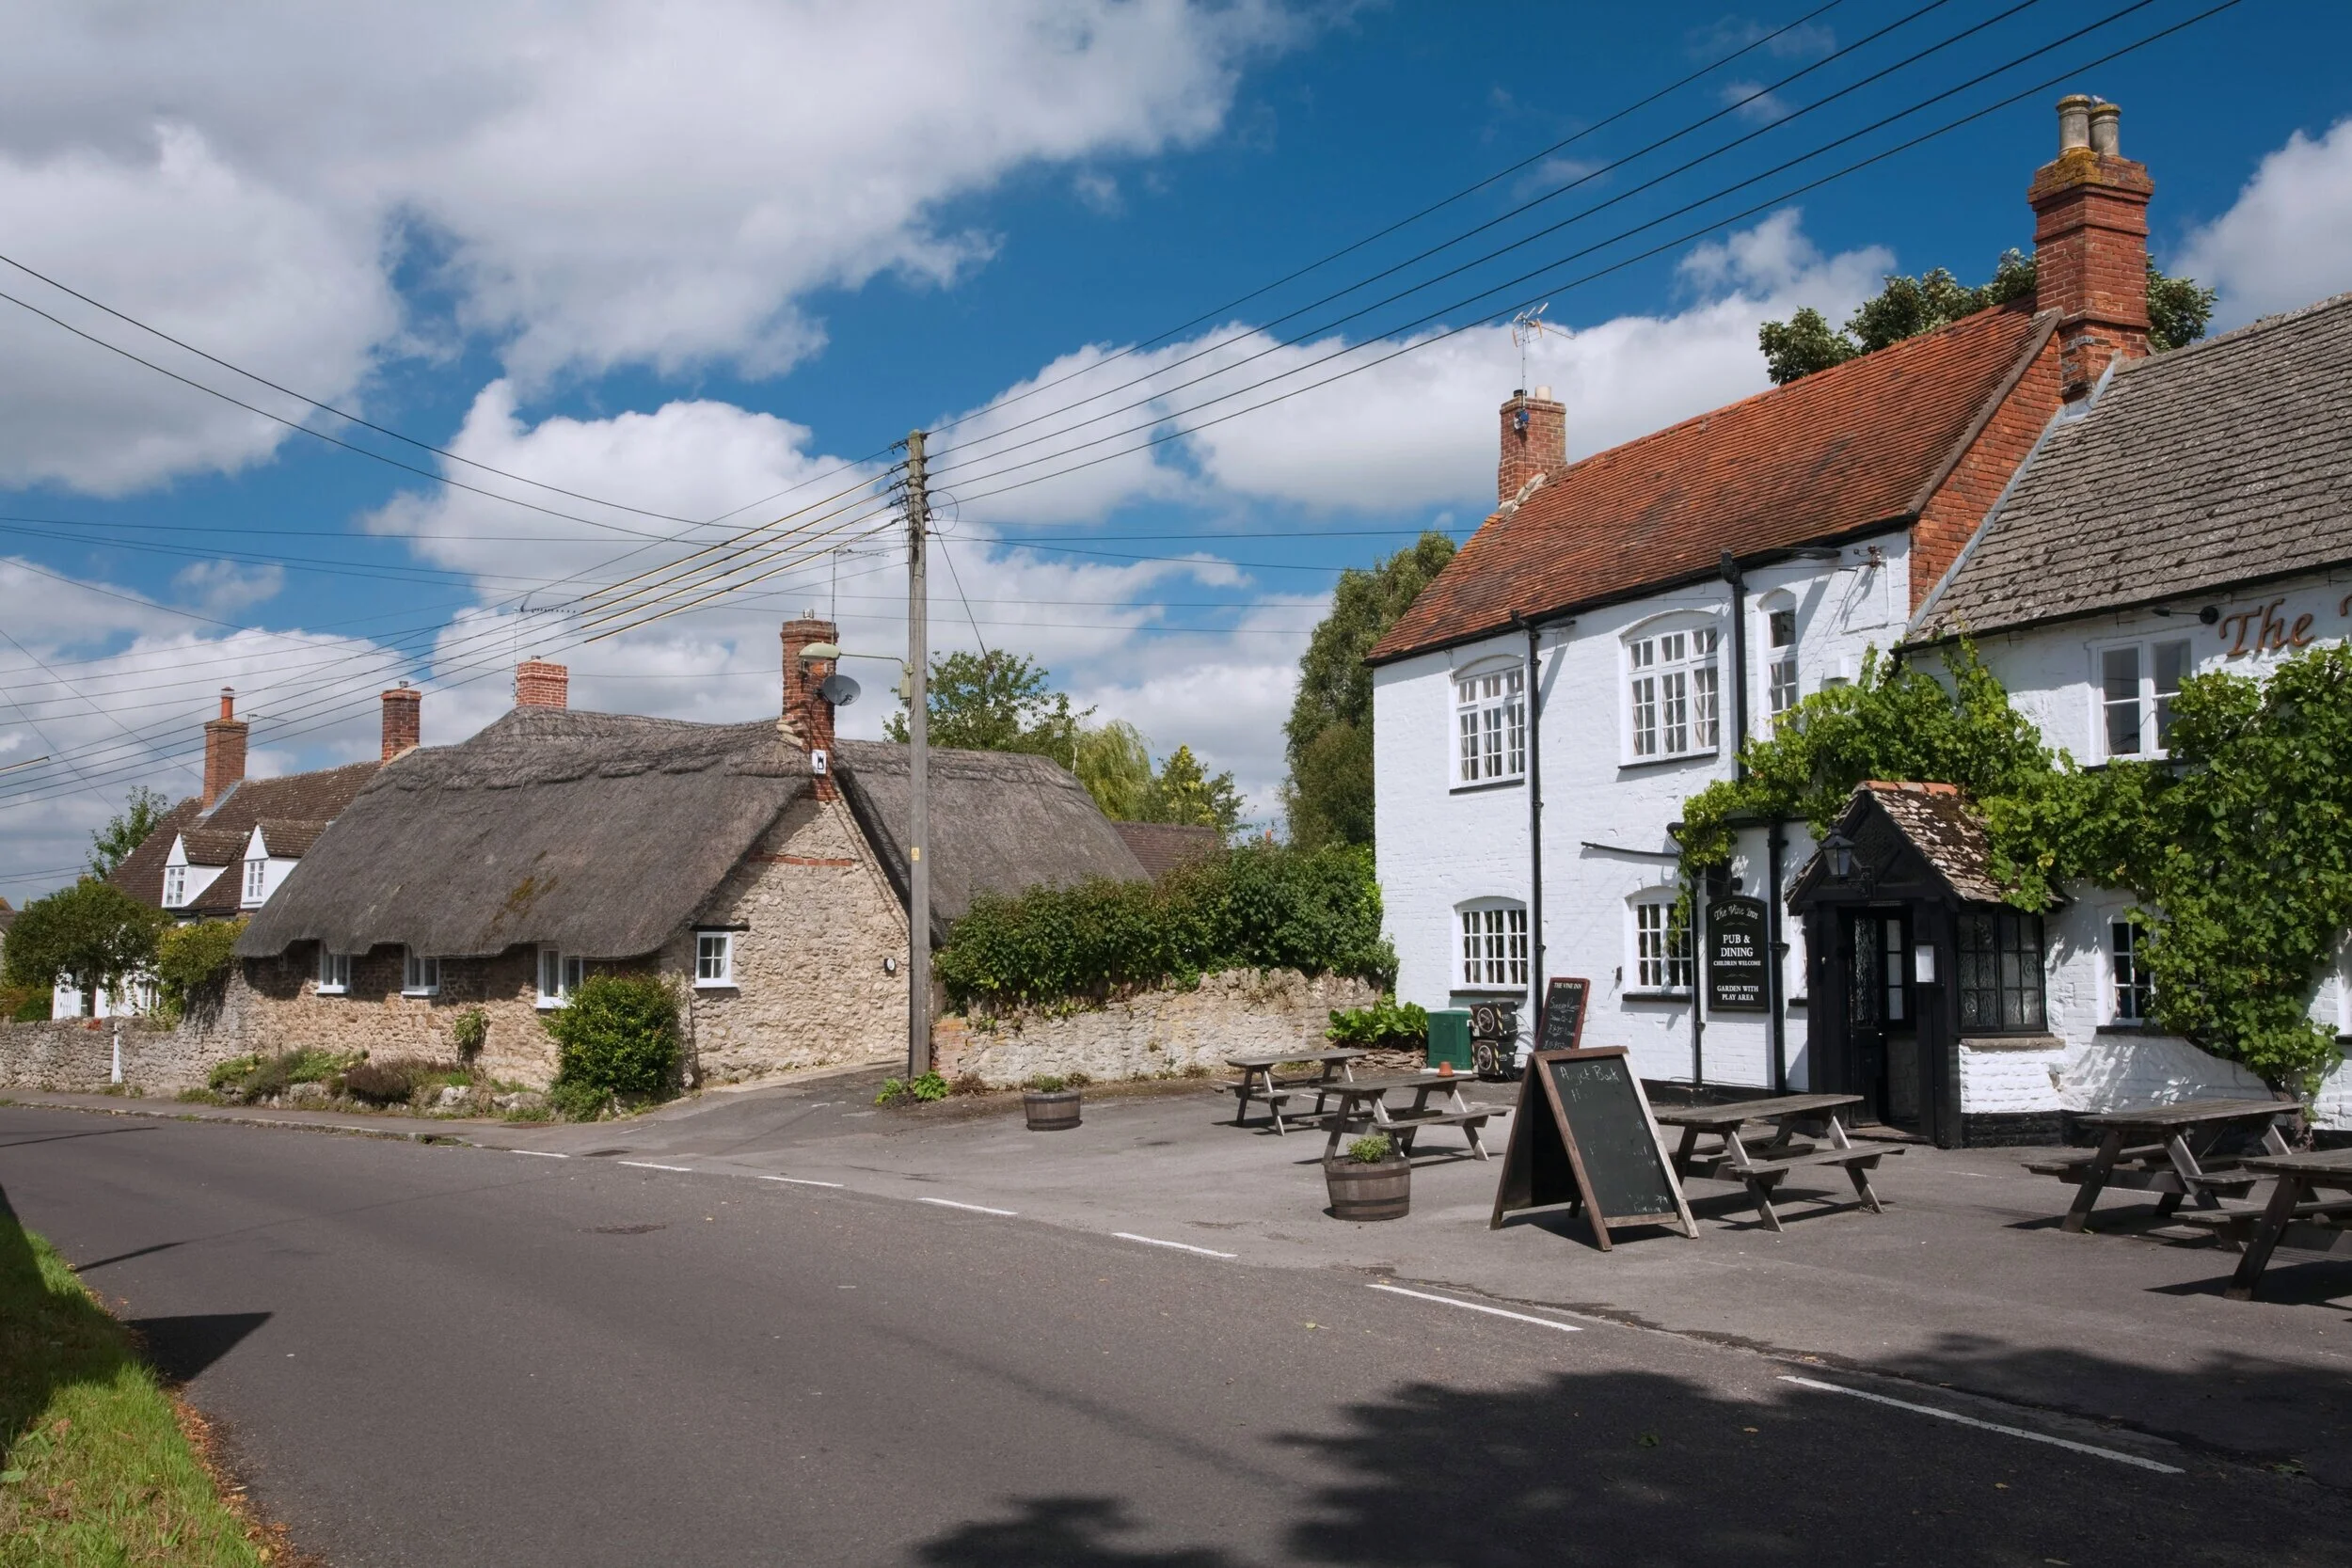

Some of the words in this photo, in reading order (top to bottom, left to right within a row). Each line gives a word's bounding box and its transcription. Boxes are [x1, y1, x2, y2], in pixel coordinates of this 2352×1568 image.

[2218, 597, 2315, 657] The
[1714, 908, 1727, 921] The
[1728, 904, 1744, 915] Vine
[1746, 908, 1758, 920] Inn
[1723, 934, 1740, 944] PUB
[1743, 934, 1751, 943] &
[1721, 947, 1754, 958] DINING
